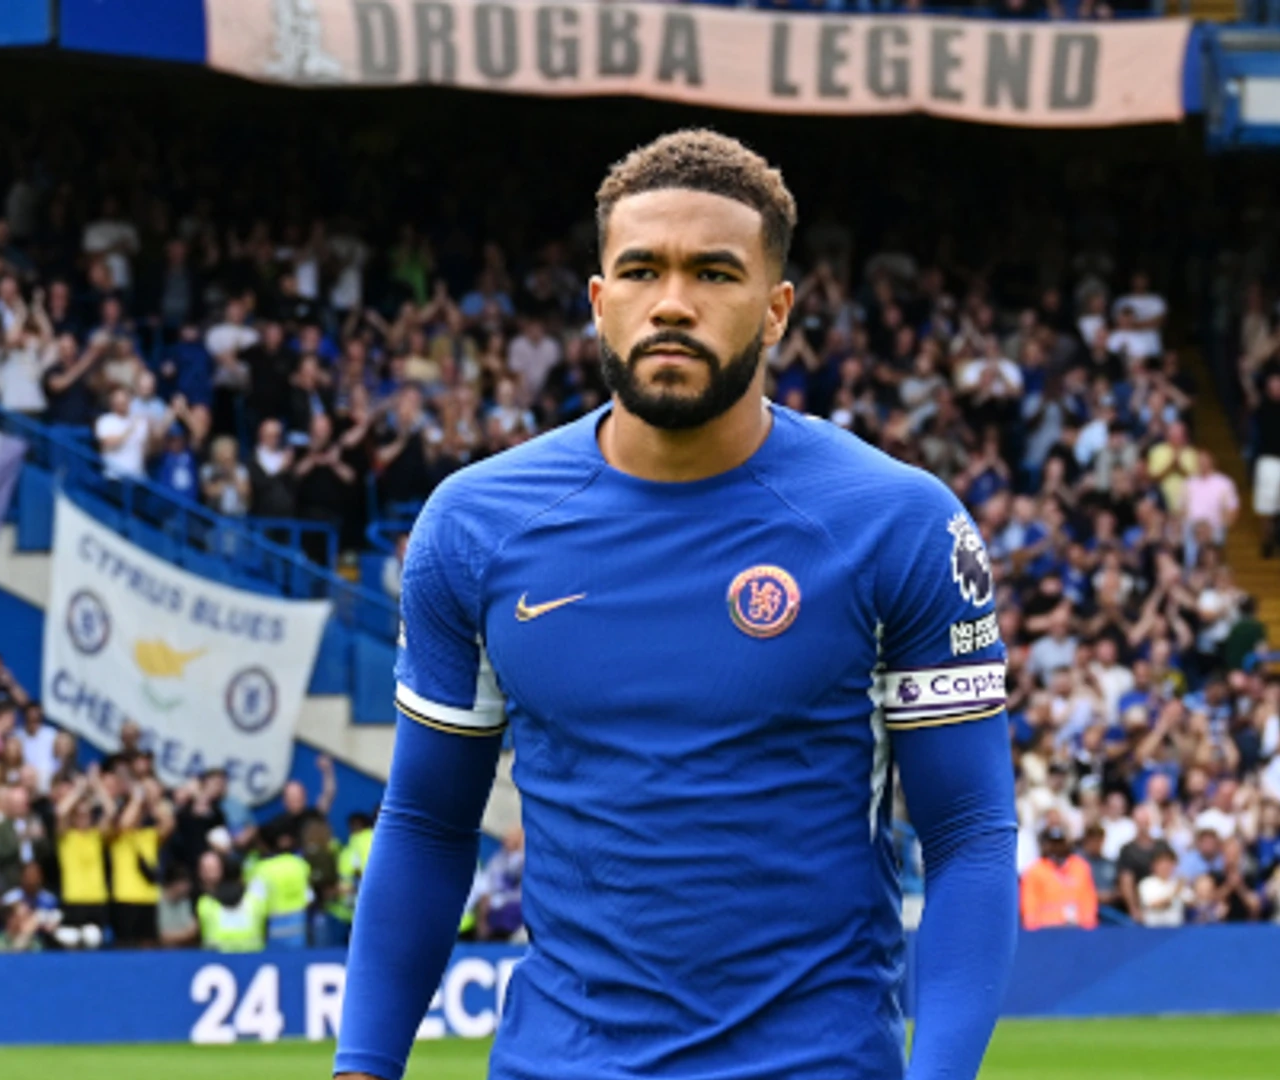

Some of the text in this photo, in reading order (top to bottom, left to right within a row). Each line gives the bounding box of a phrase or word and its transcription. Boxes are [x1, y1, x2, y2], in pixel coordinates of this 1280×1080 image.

[354, 0, 1101, 111] DROGBA LEGEND
[79, 533, 285, 643] CYPRUS BLUES
[52, 669, 207, 778] CHESEA
[191, 963, 285, 1044] 24
